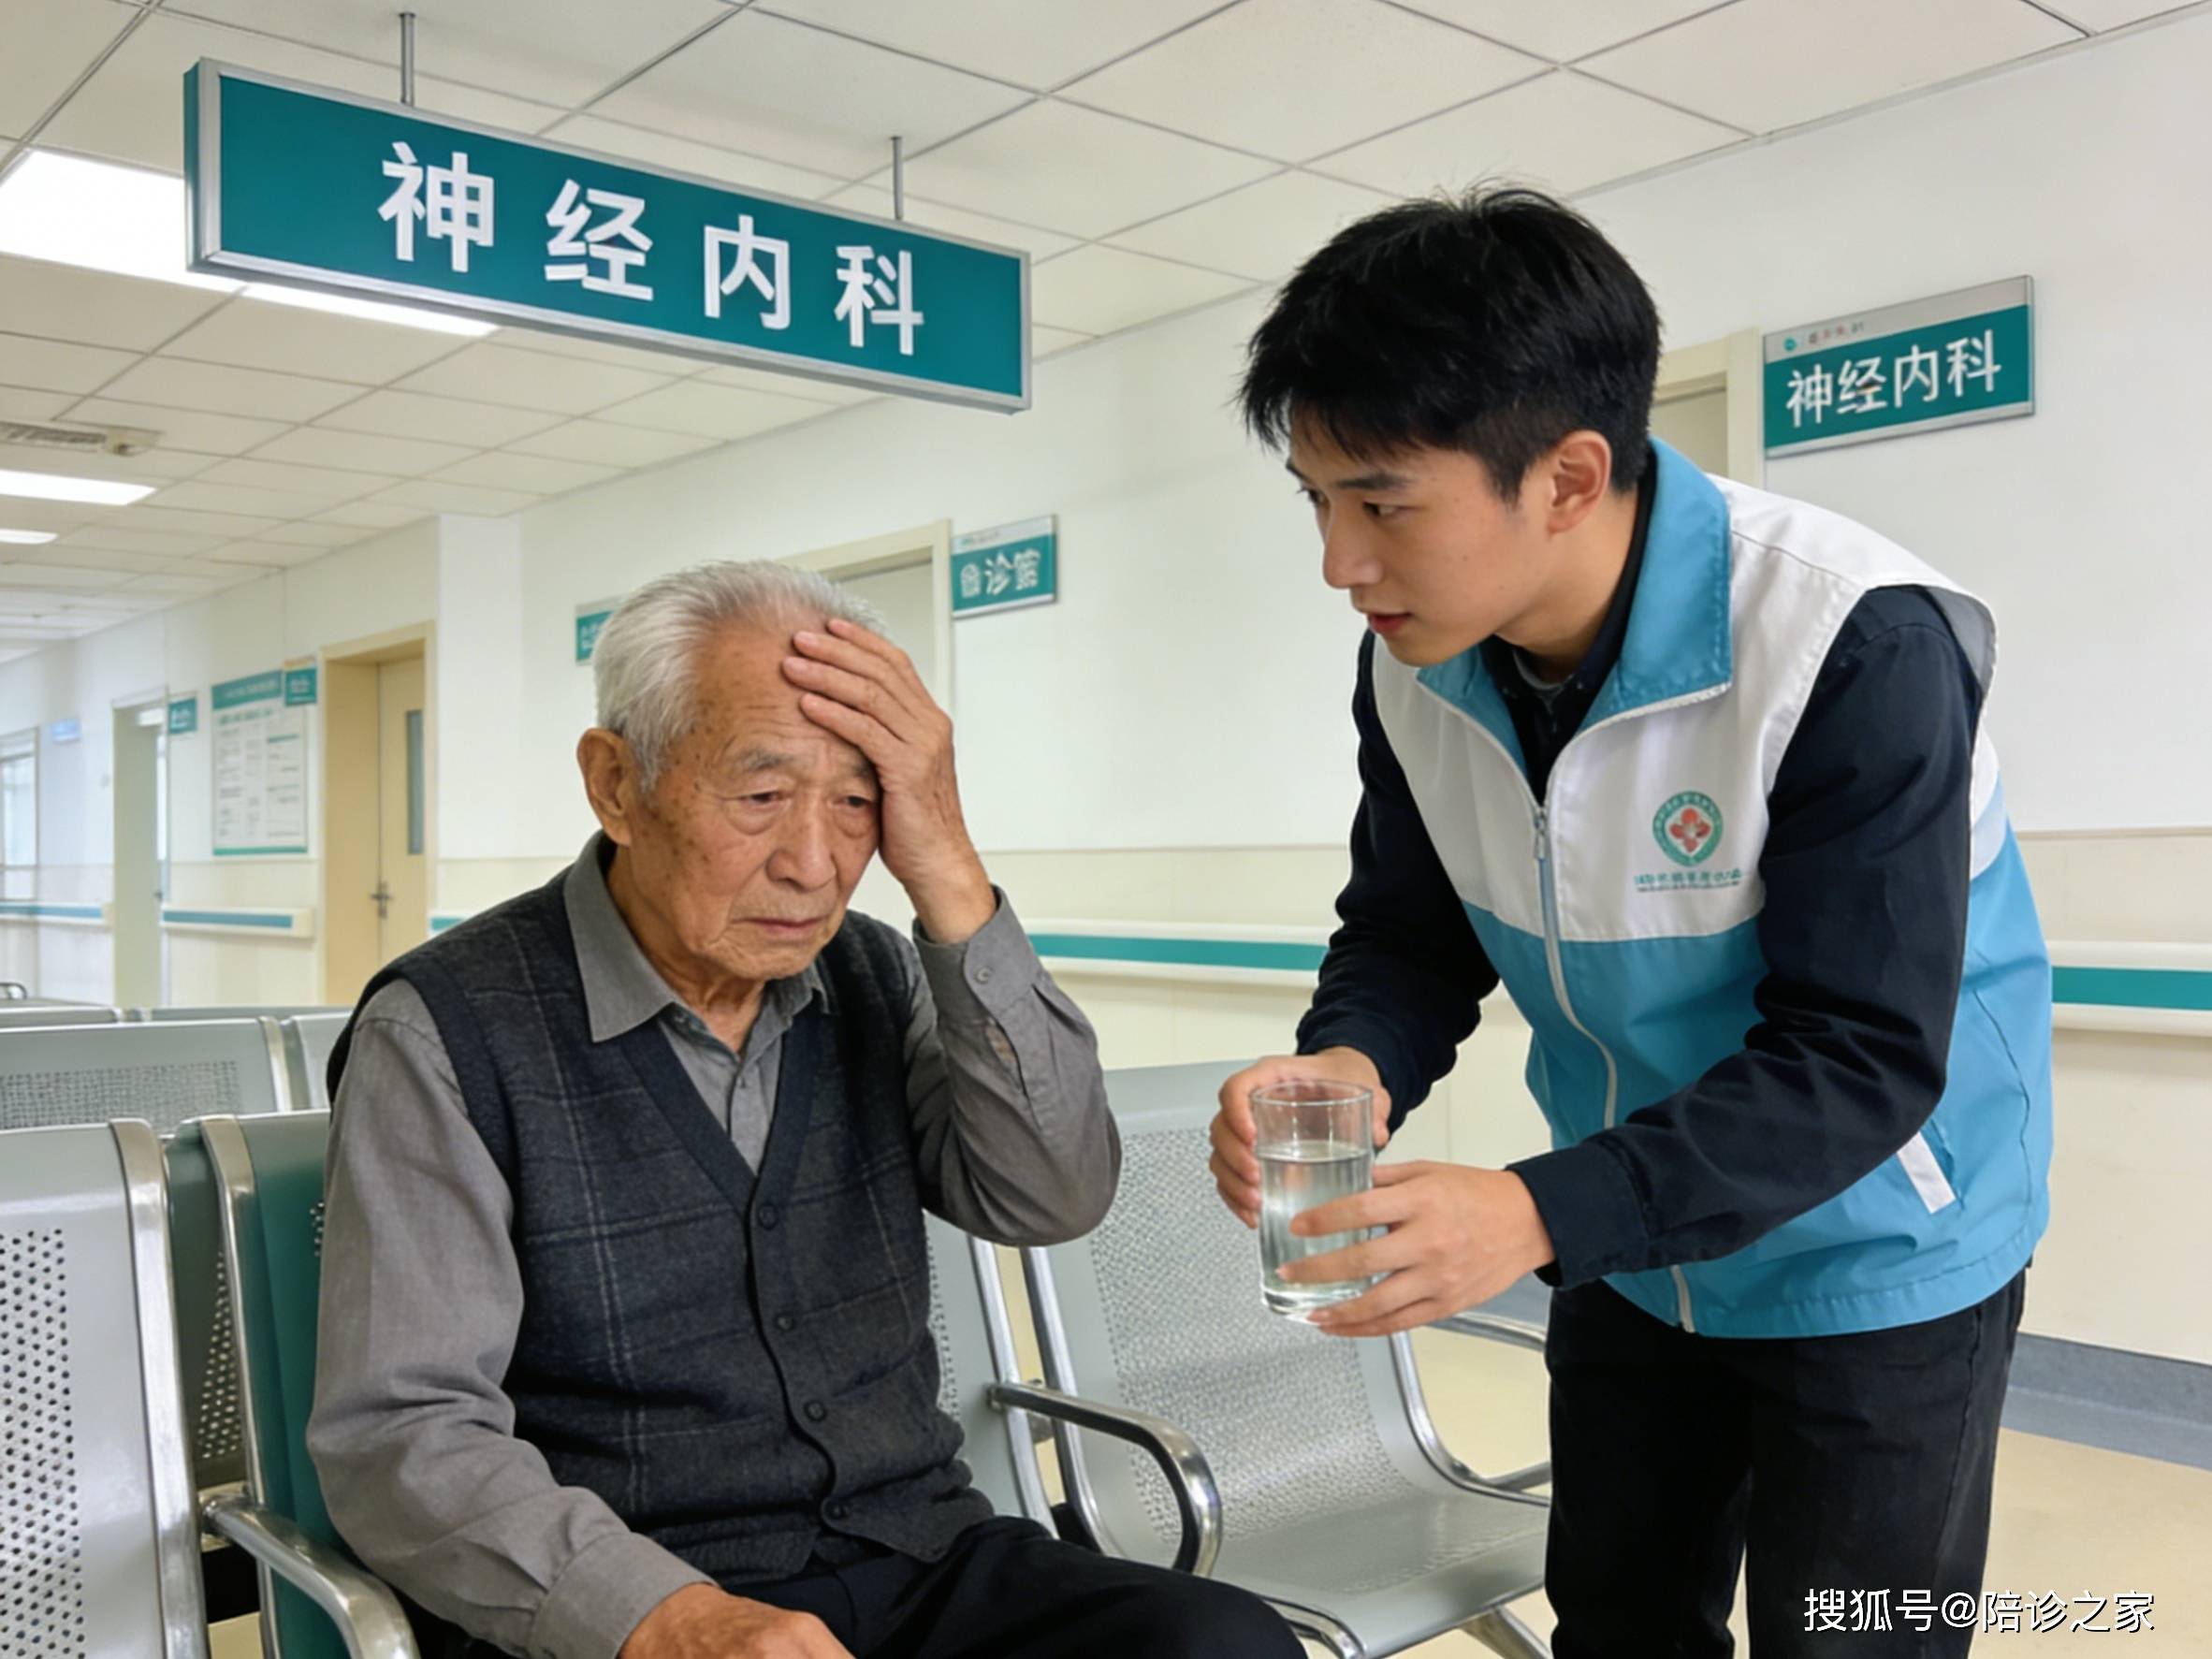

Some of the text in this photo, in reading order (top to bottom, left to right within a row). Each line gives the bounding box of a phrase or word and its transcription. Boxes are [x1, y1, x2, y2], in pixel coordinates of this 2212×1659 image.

[377, 141, 924, 355] 神经内科
[1785, 329, 2001, 428] 神经内科
